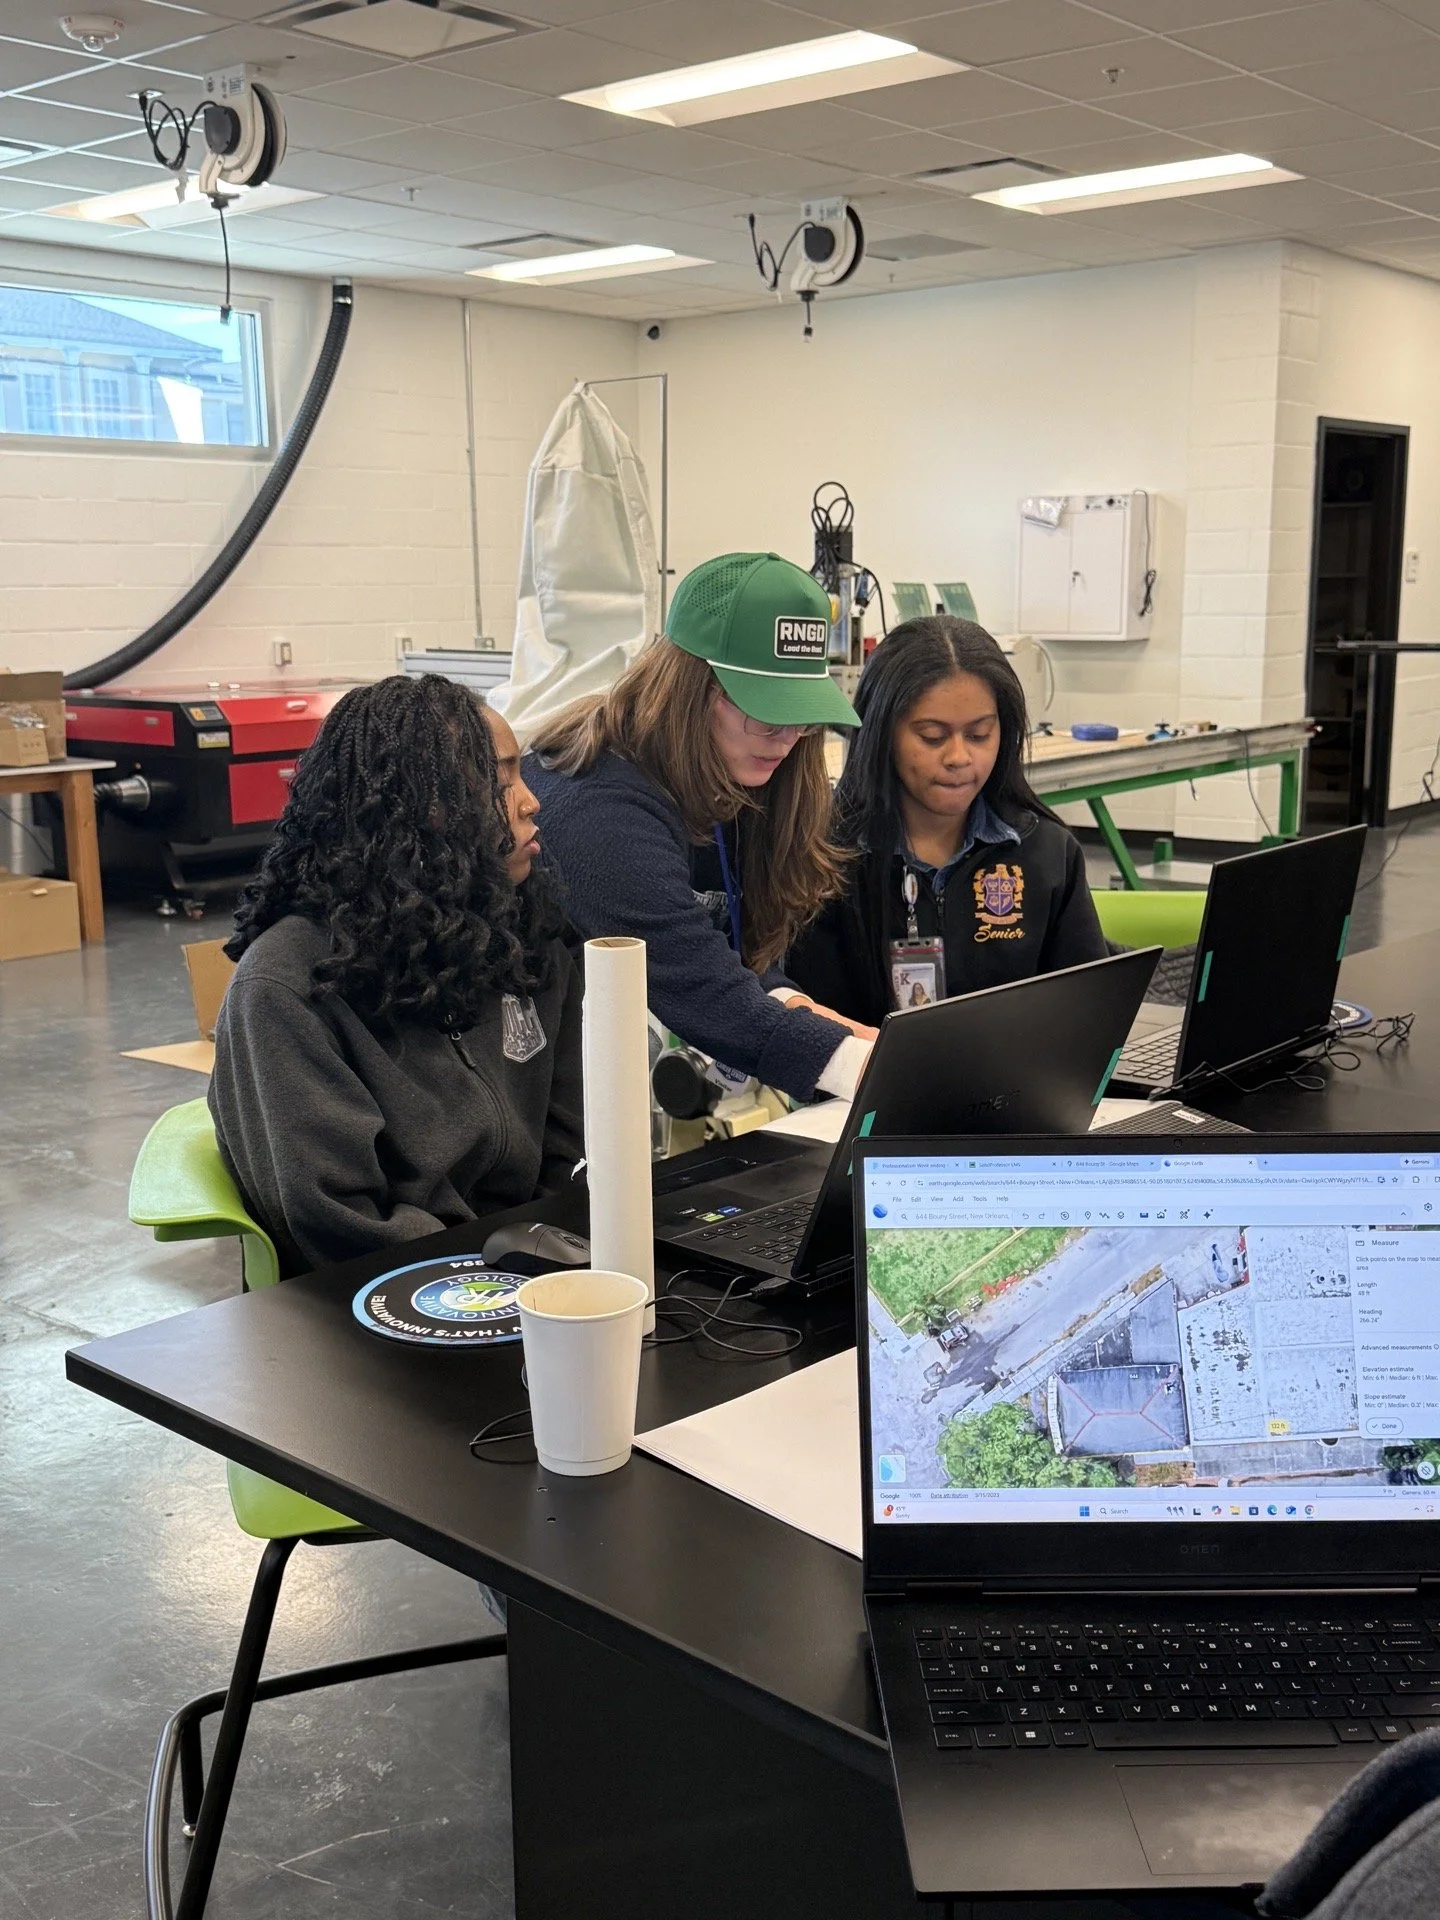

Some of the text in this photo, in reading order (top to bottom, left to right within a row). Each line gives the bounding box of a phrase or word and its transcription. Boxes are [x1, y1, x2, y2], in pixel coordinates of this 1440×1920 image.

[780, 622, 825, 642] RNGD
[800, 645, 811, 653] the
[974, 923, 1025, 943] Senior
[900, 973, 911, 985] K
[420, 1295, 521, 1319] INNOVATIVE
[433, 1328, 506, 1338] THAT'S
